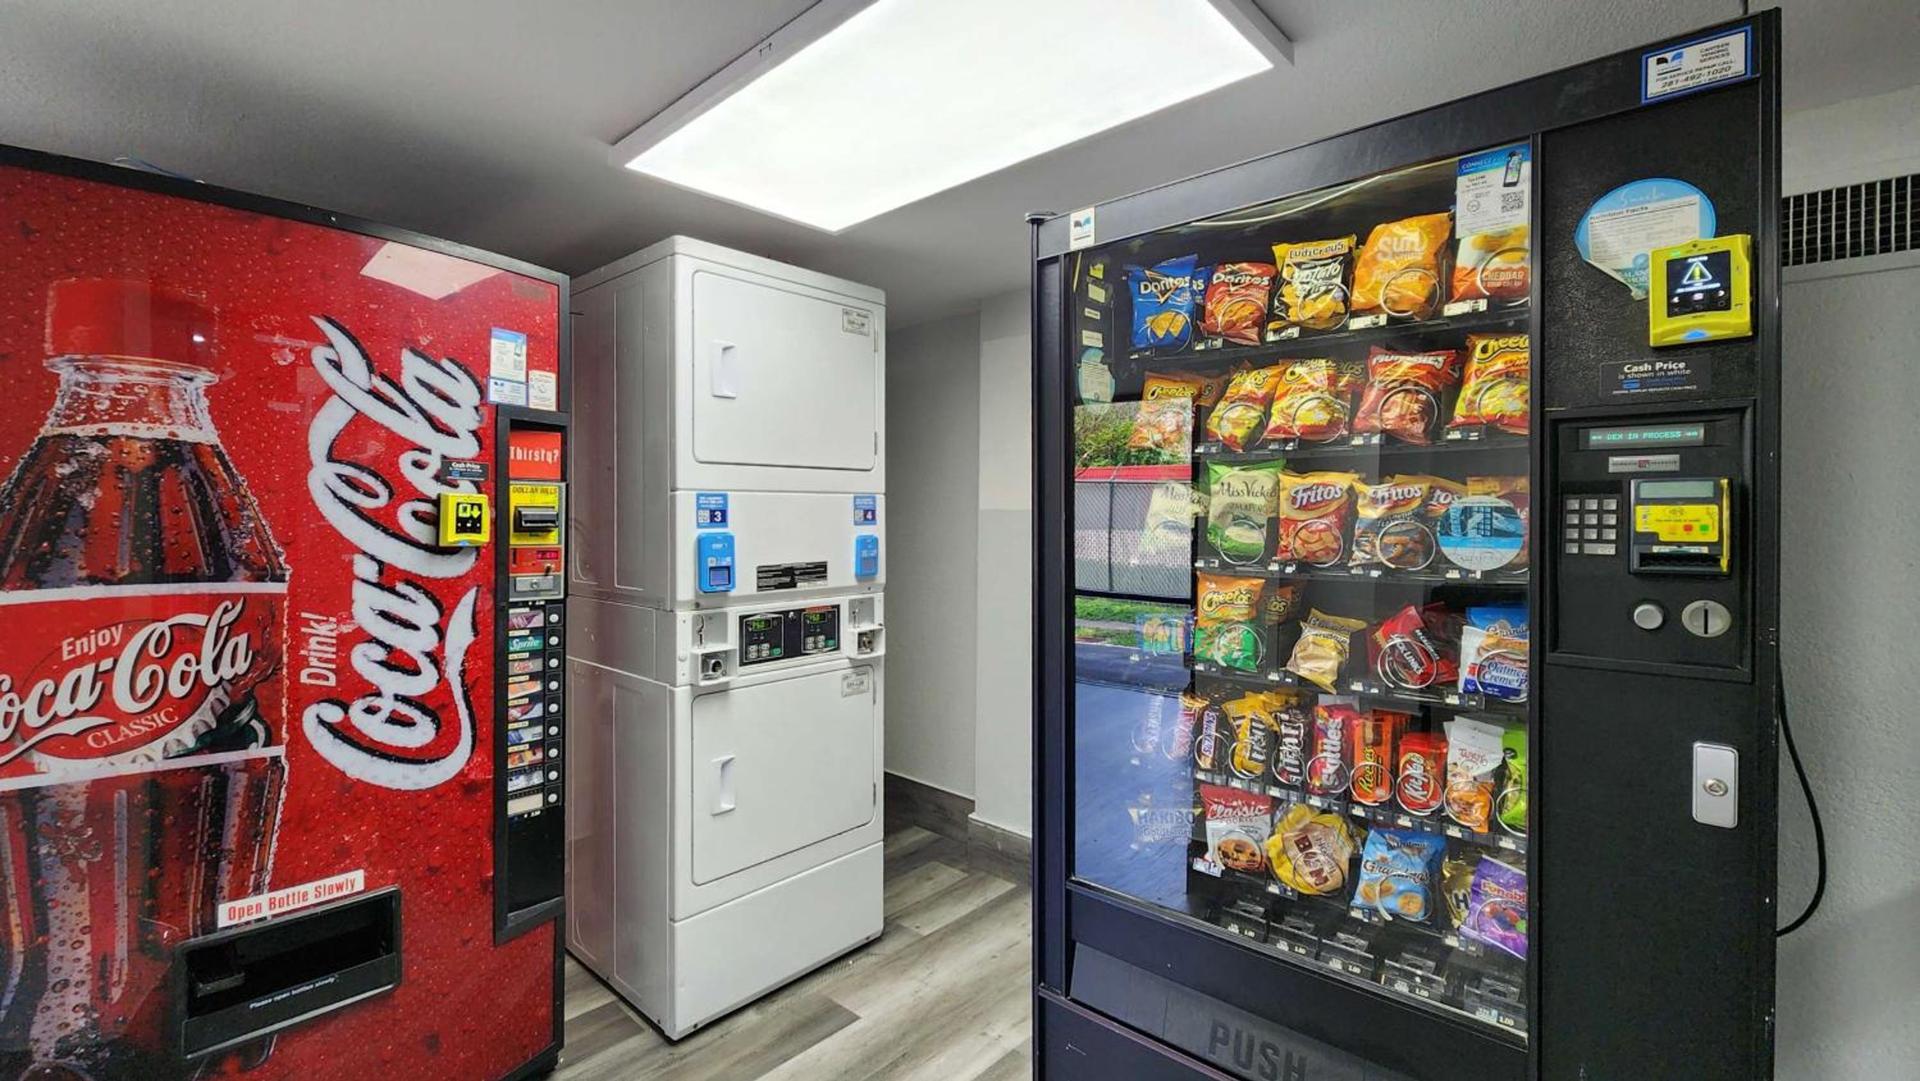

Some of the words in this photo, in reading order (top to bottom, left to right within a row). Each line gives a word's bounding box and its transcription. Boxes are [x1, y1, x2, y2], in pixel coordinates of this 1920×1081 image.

[1140, 275, 1192, 295] Doritos
[1212, 271, 1271, 288] Doritos
[1623, 363, 1652, 374] Cash
[1655, 360, 1686, 371] Price
[1627, 370, 1655, 380] shown
[1656, 369, 1665, 378] in
[1666, 367, 1692, 377] white
[1627, 430, 1639, 440] IN
[1291, 482, 1344, 508] Fritos
[1370, 484, 1423, 506] Fritos
[713, 511, 722, 523] 3
[865, 510, 873, 521] 4
[1201, 588, 1254, 612] Cheetos
[61, 624, 123, 661] Enjoy
[300, 611, 337, 688] Drink!
[511, 636, 541, 651] Sprite
[0, 596, 253, 748] oca-Cola
[86, 706, 179, 749] CLASSIC
[1201, 710, 1217, 758] SNICKERS
[1321, 715, 1344, 787] Skittles
[1357, 745, 1377, 795] Reese's
[1207, 802, 1269, 821] Classic
[228, 902, 262, 922] Open
[268, 890, 309, 912] Bottle
[314, 876, 357, 895] Slowly
[1207, 1020, 1308, 1081] PUSH
